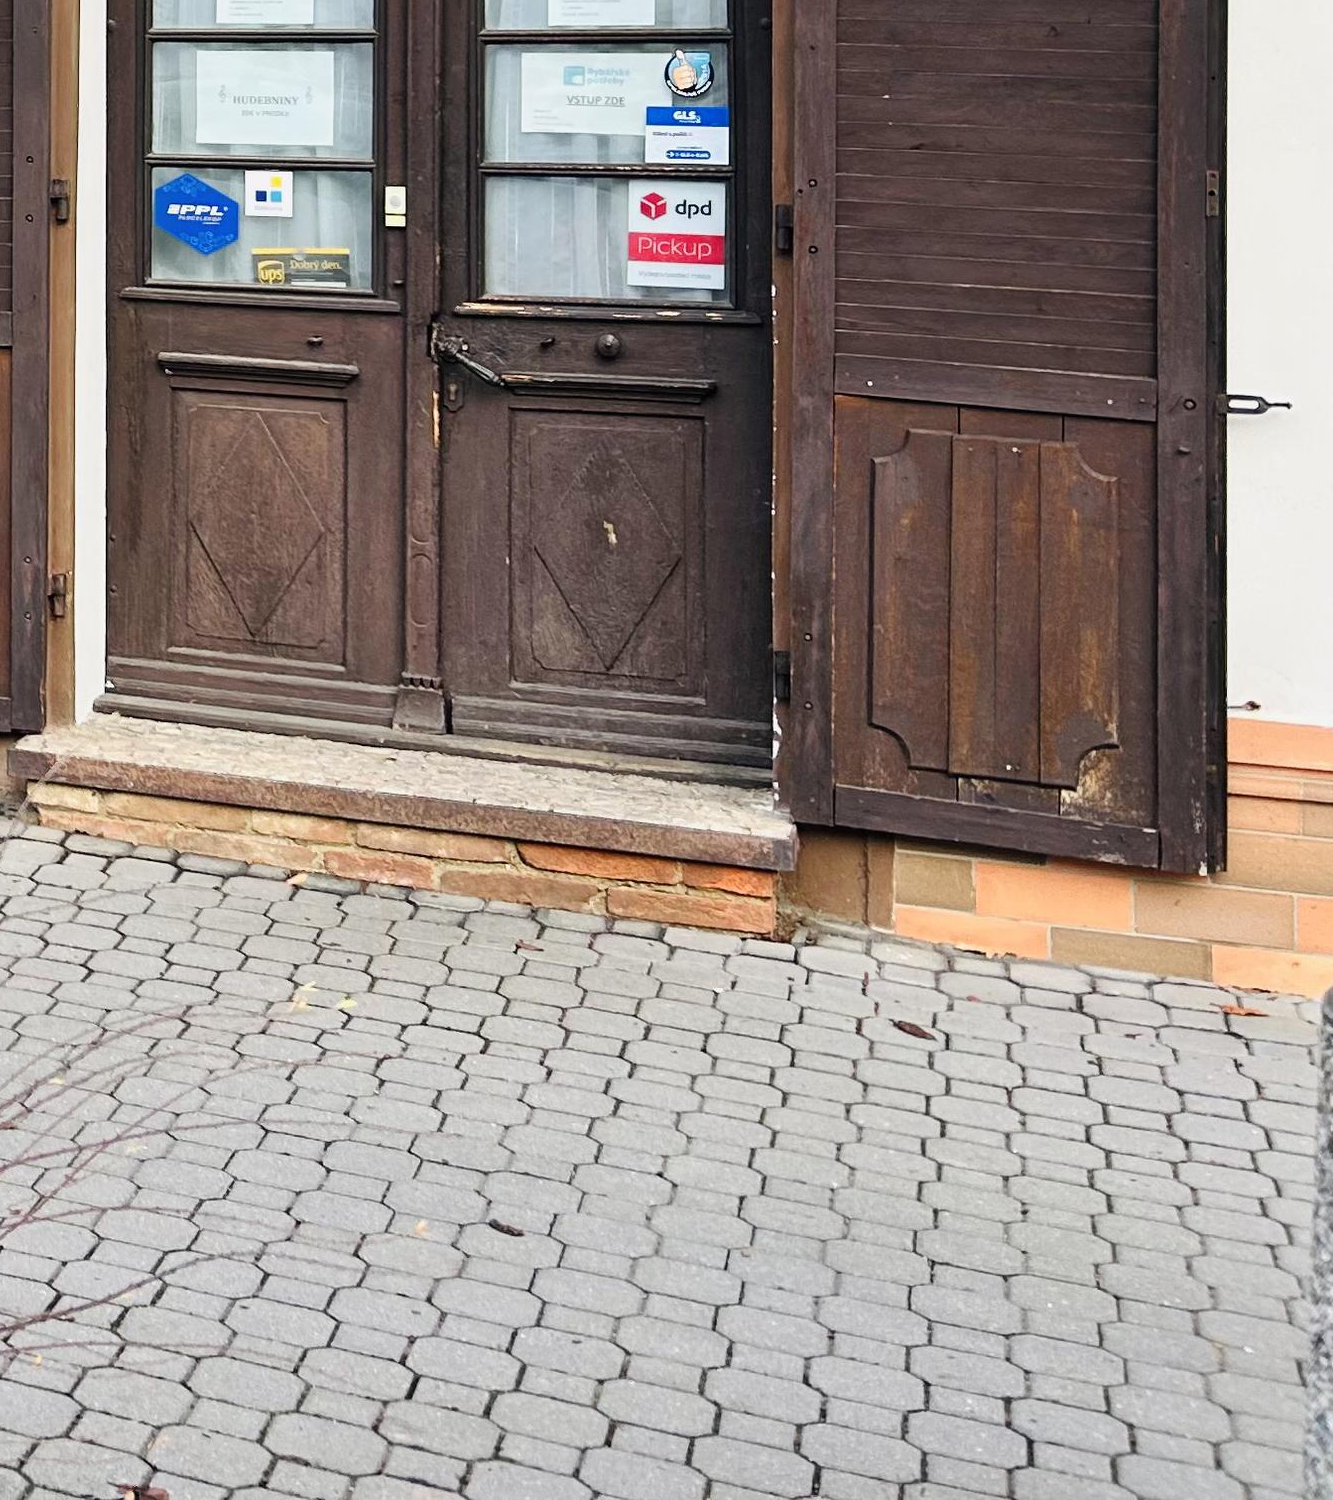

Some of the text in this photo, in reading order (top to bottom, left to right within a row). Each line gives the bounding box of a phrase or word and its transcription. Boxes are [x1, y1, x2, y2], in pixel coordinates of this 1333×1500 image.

[233, 95, 300, 106] HUDEBNINY
[566, 95, 626, 106] VSTUP ZDE
[673, 110, 697, 121] GLS
[183, 203, 224, 216] PPL
[674, 199, 712, 219] dpd
[638, 236, 712, 260] Pickup
[290, 259, 319, 270] Dobrý
[261, 268, 283, 285] ups
